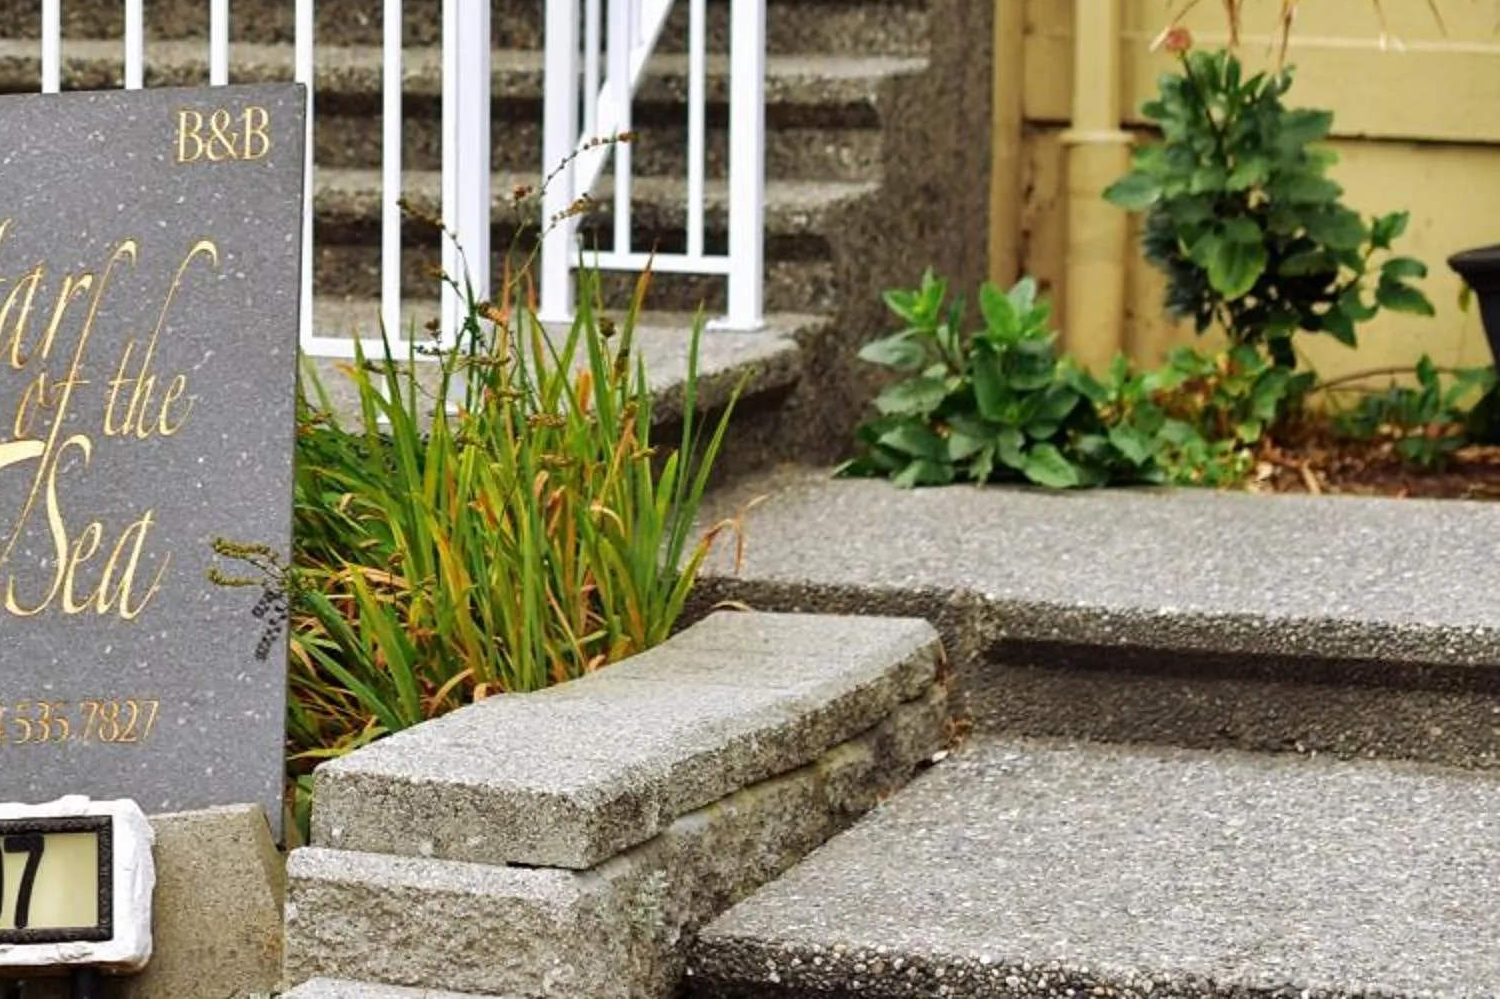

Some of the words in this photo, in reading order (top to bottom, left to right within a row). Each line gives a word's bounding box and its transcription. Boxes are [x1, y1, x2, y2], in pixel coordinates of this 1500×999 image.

[178, 106, 270, 162] B&B
[103, 239, 219, 439] the
[6, 433, 172, 620] Sea
[78, 696, 161, 744] 7827
